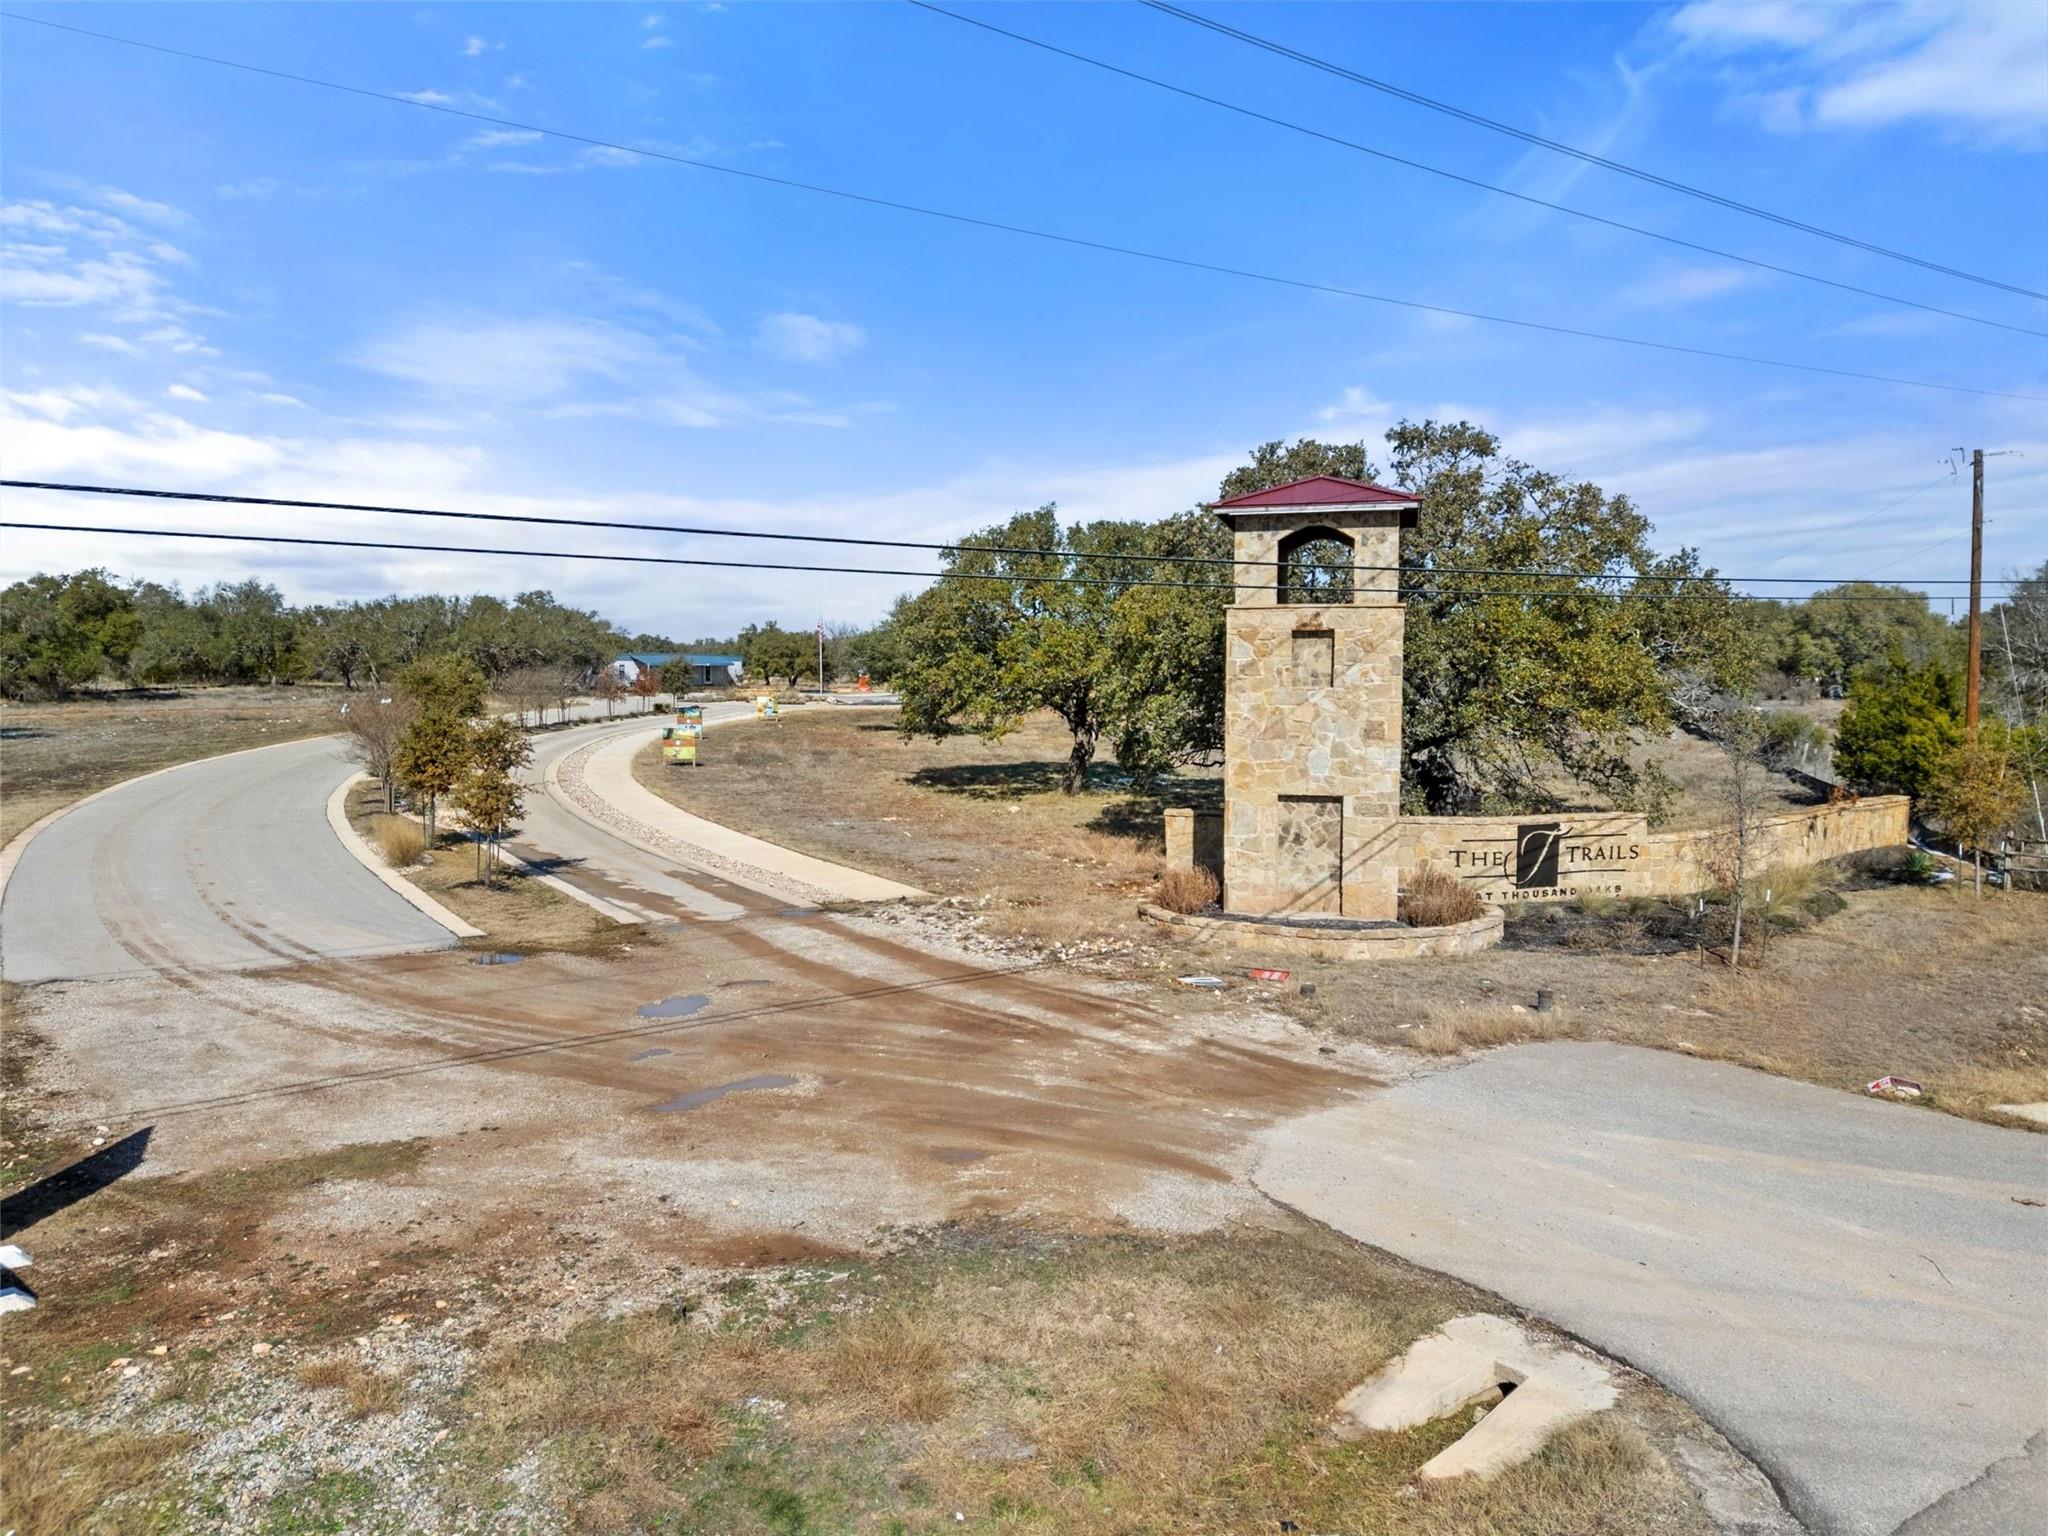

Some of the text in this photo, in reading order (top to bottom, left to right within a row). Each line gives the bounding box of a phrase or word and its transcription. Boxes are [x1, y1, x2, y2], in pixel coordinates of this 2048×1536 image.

[1449, 844, 1640, 867] THE TRAILS
[1475, 891, 1493, 901] AT
[1501, 886, 1577, 900] THOUSAND
